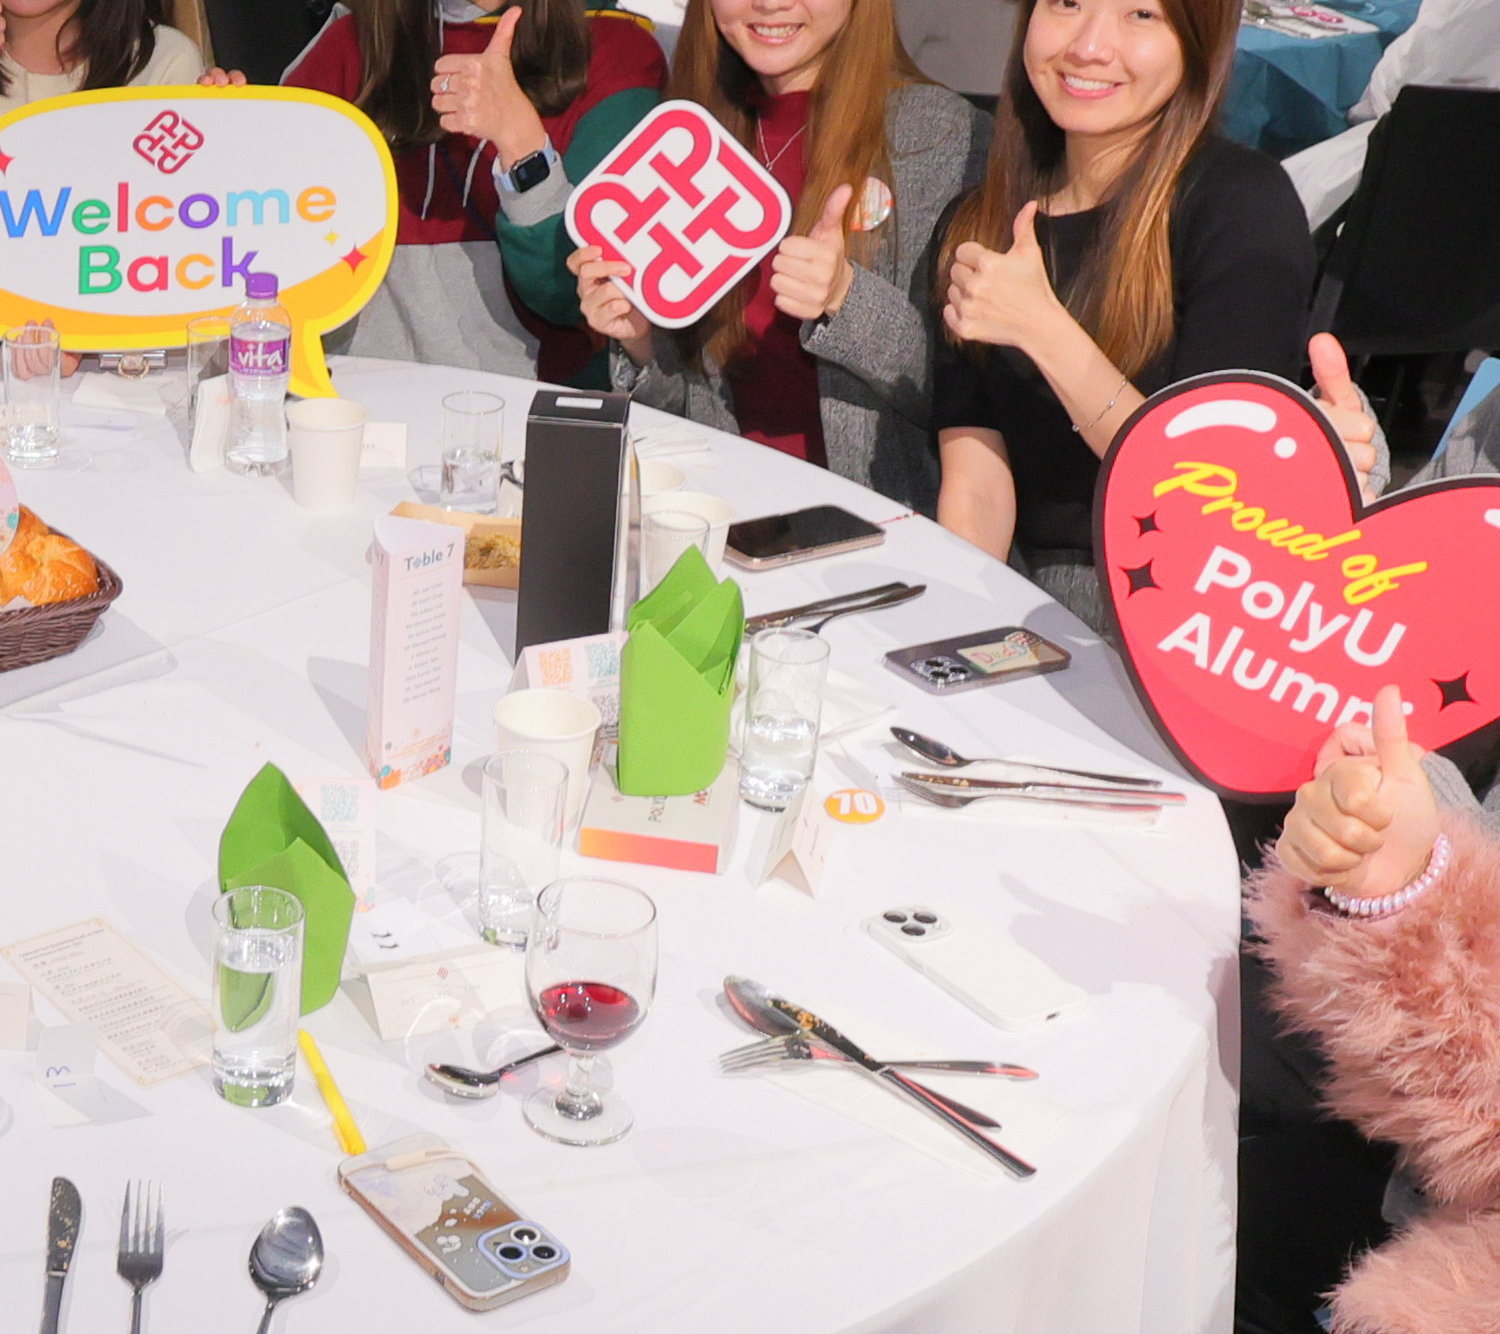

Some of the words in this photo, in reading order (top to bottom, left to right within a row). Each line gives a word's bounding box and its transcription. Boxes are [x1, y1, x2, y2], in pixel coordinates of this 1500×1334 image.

[77, 236, 260, 295] Back
[238, 342, 283, 368] vita
[446, 542, 456, 559] 7
[1153, 460, 1362, 562] Proud
[1342, 558, 1427, 606] of
[1194, 545, 1406, 667] PolyU
[1156, 612, 1414, 729] Alumn
[832, 791, 878, 816] 70
